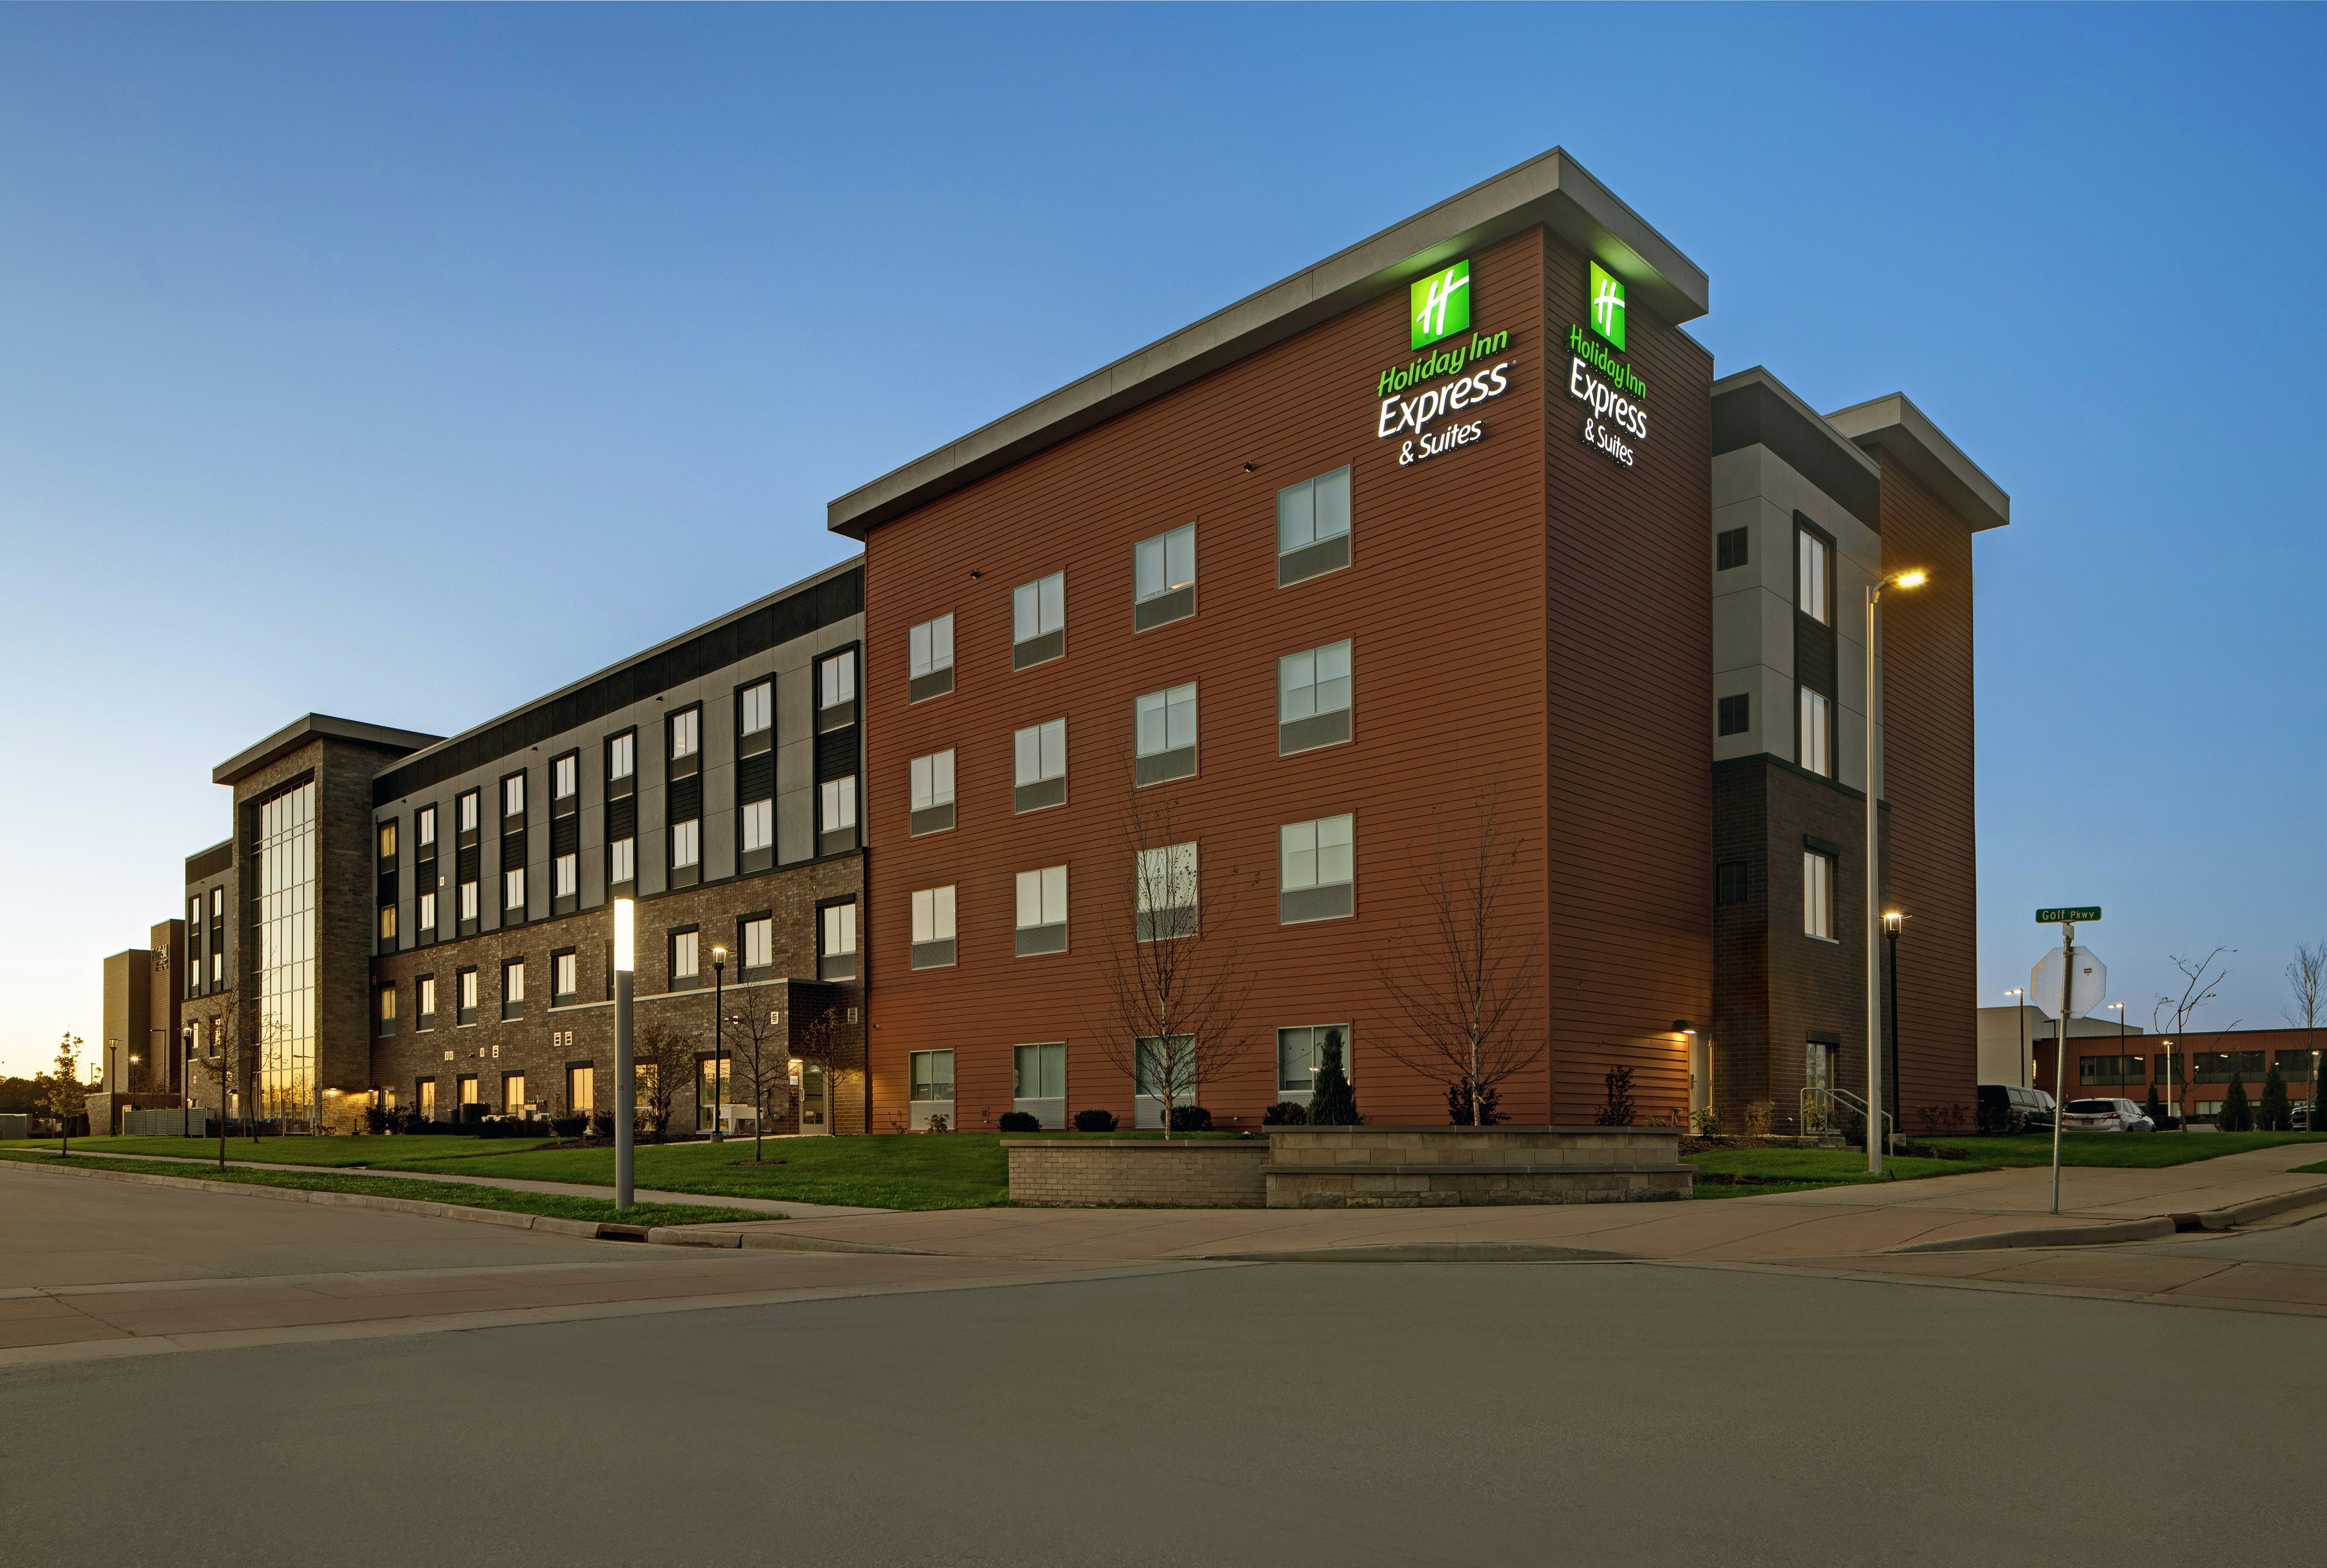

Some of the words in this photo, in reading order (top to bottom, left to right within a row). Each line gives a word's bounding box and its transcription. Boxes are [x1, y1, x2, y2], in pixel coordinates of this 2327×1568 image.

[1377, 346, 1467, 397] Holiday
[1470, 330, 1507, 361] Inn
[1570, 324, 1624, 389] Holiday
[1626, 363, 1646, 399] Inn
[1377, 363, 1509, 439] Express
[1571, 357, 1647, 439] Express
[1399, 441, 1413, 466] &
[1418, 420, 1482, 460] Suites
[1585, 418, 1595, 443] &
[1597, 425, 1633, 466] Suites
[2042, 909, 2065, 920] Golf
[2071, 911, 2094, 919] Pkwy
